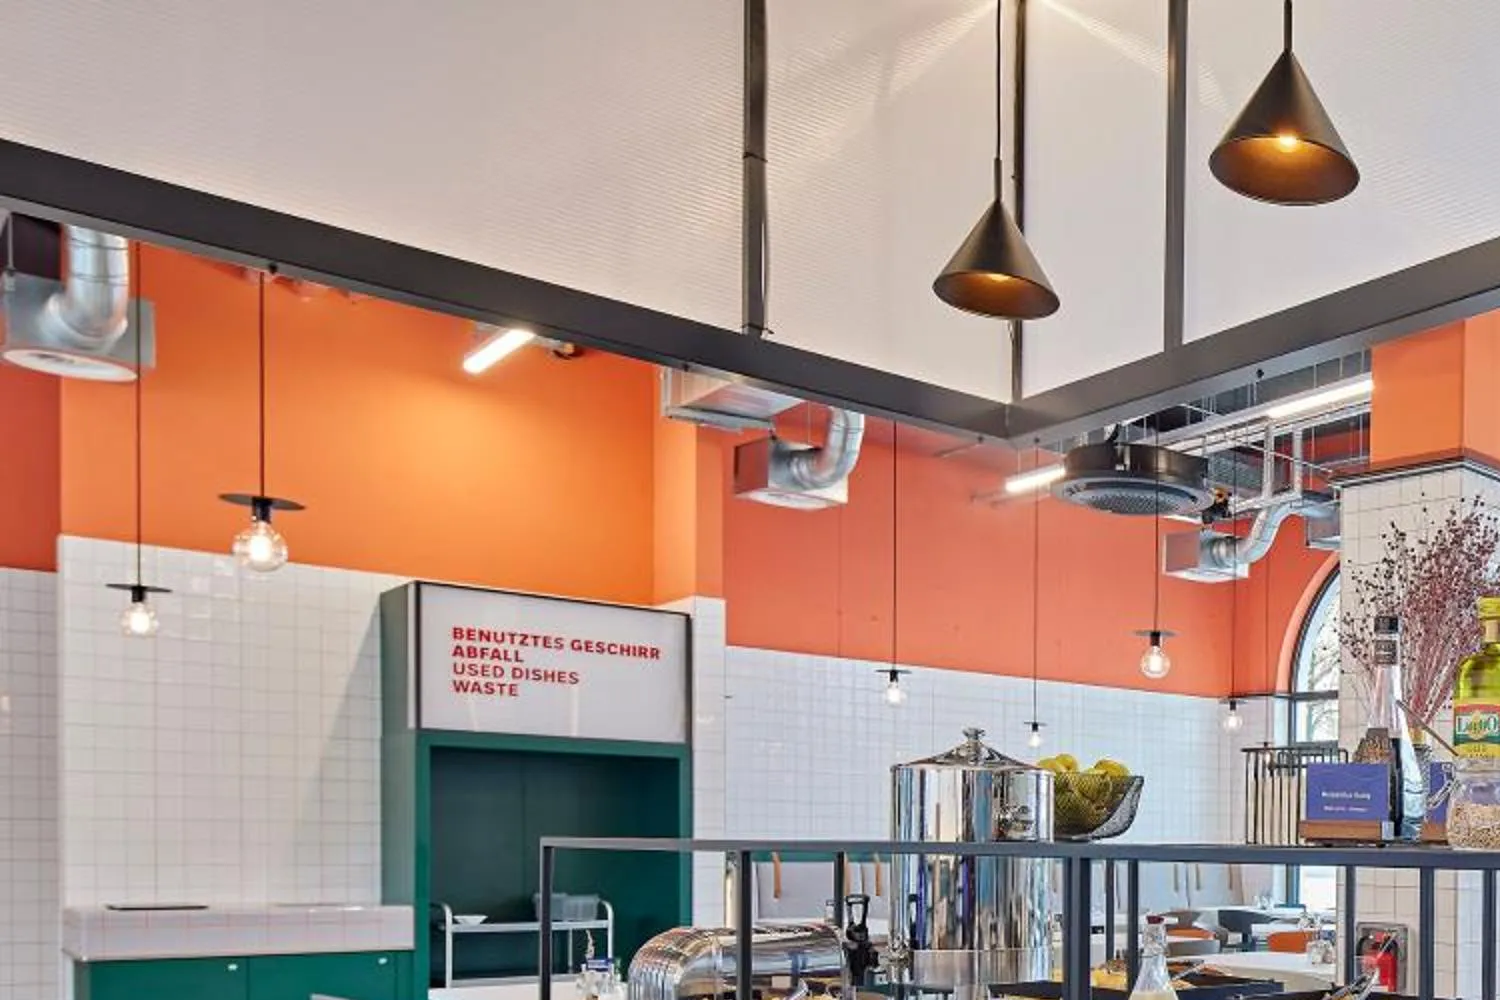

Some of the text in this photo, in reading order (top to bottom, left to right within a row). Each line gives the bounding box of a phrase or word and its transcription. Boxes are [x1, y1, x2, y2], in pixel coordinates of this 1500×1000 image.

[452, 627, 661, 660] BENUTZTES GESCHIRR
[452, 644, 525, 663] ABFALL
[452, 663, 580, 685] USED DISHES
[452, 679, 519, 697] WASTE
